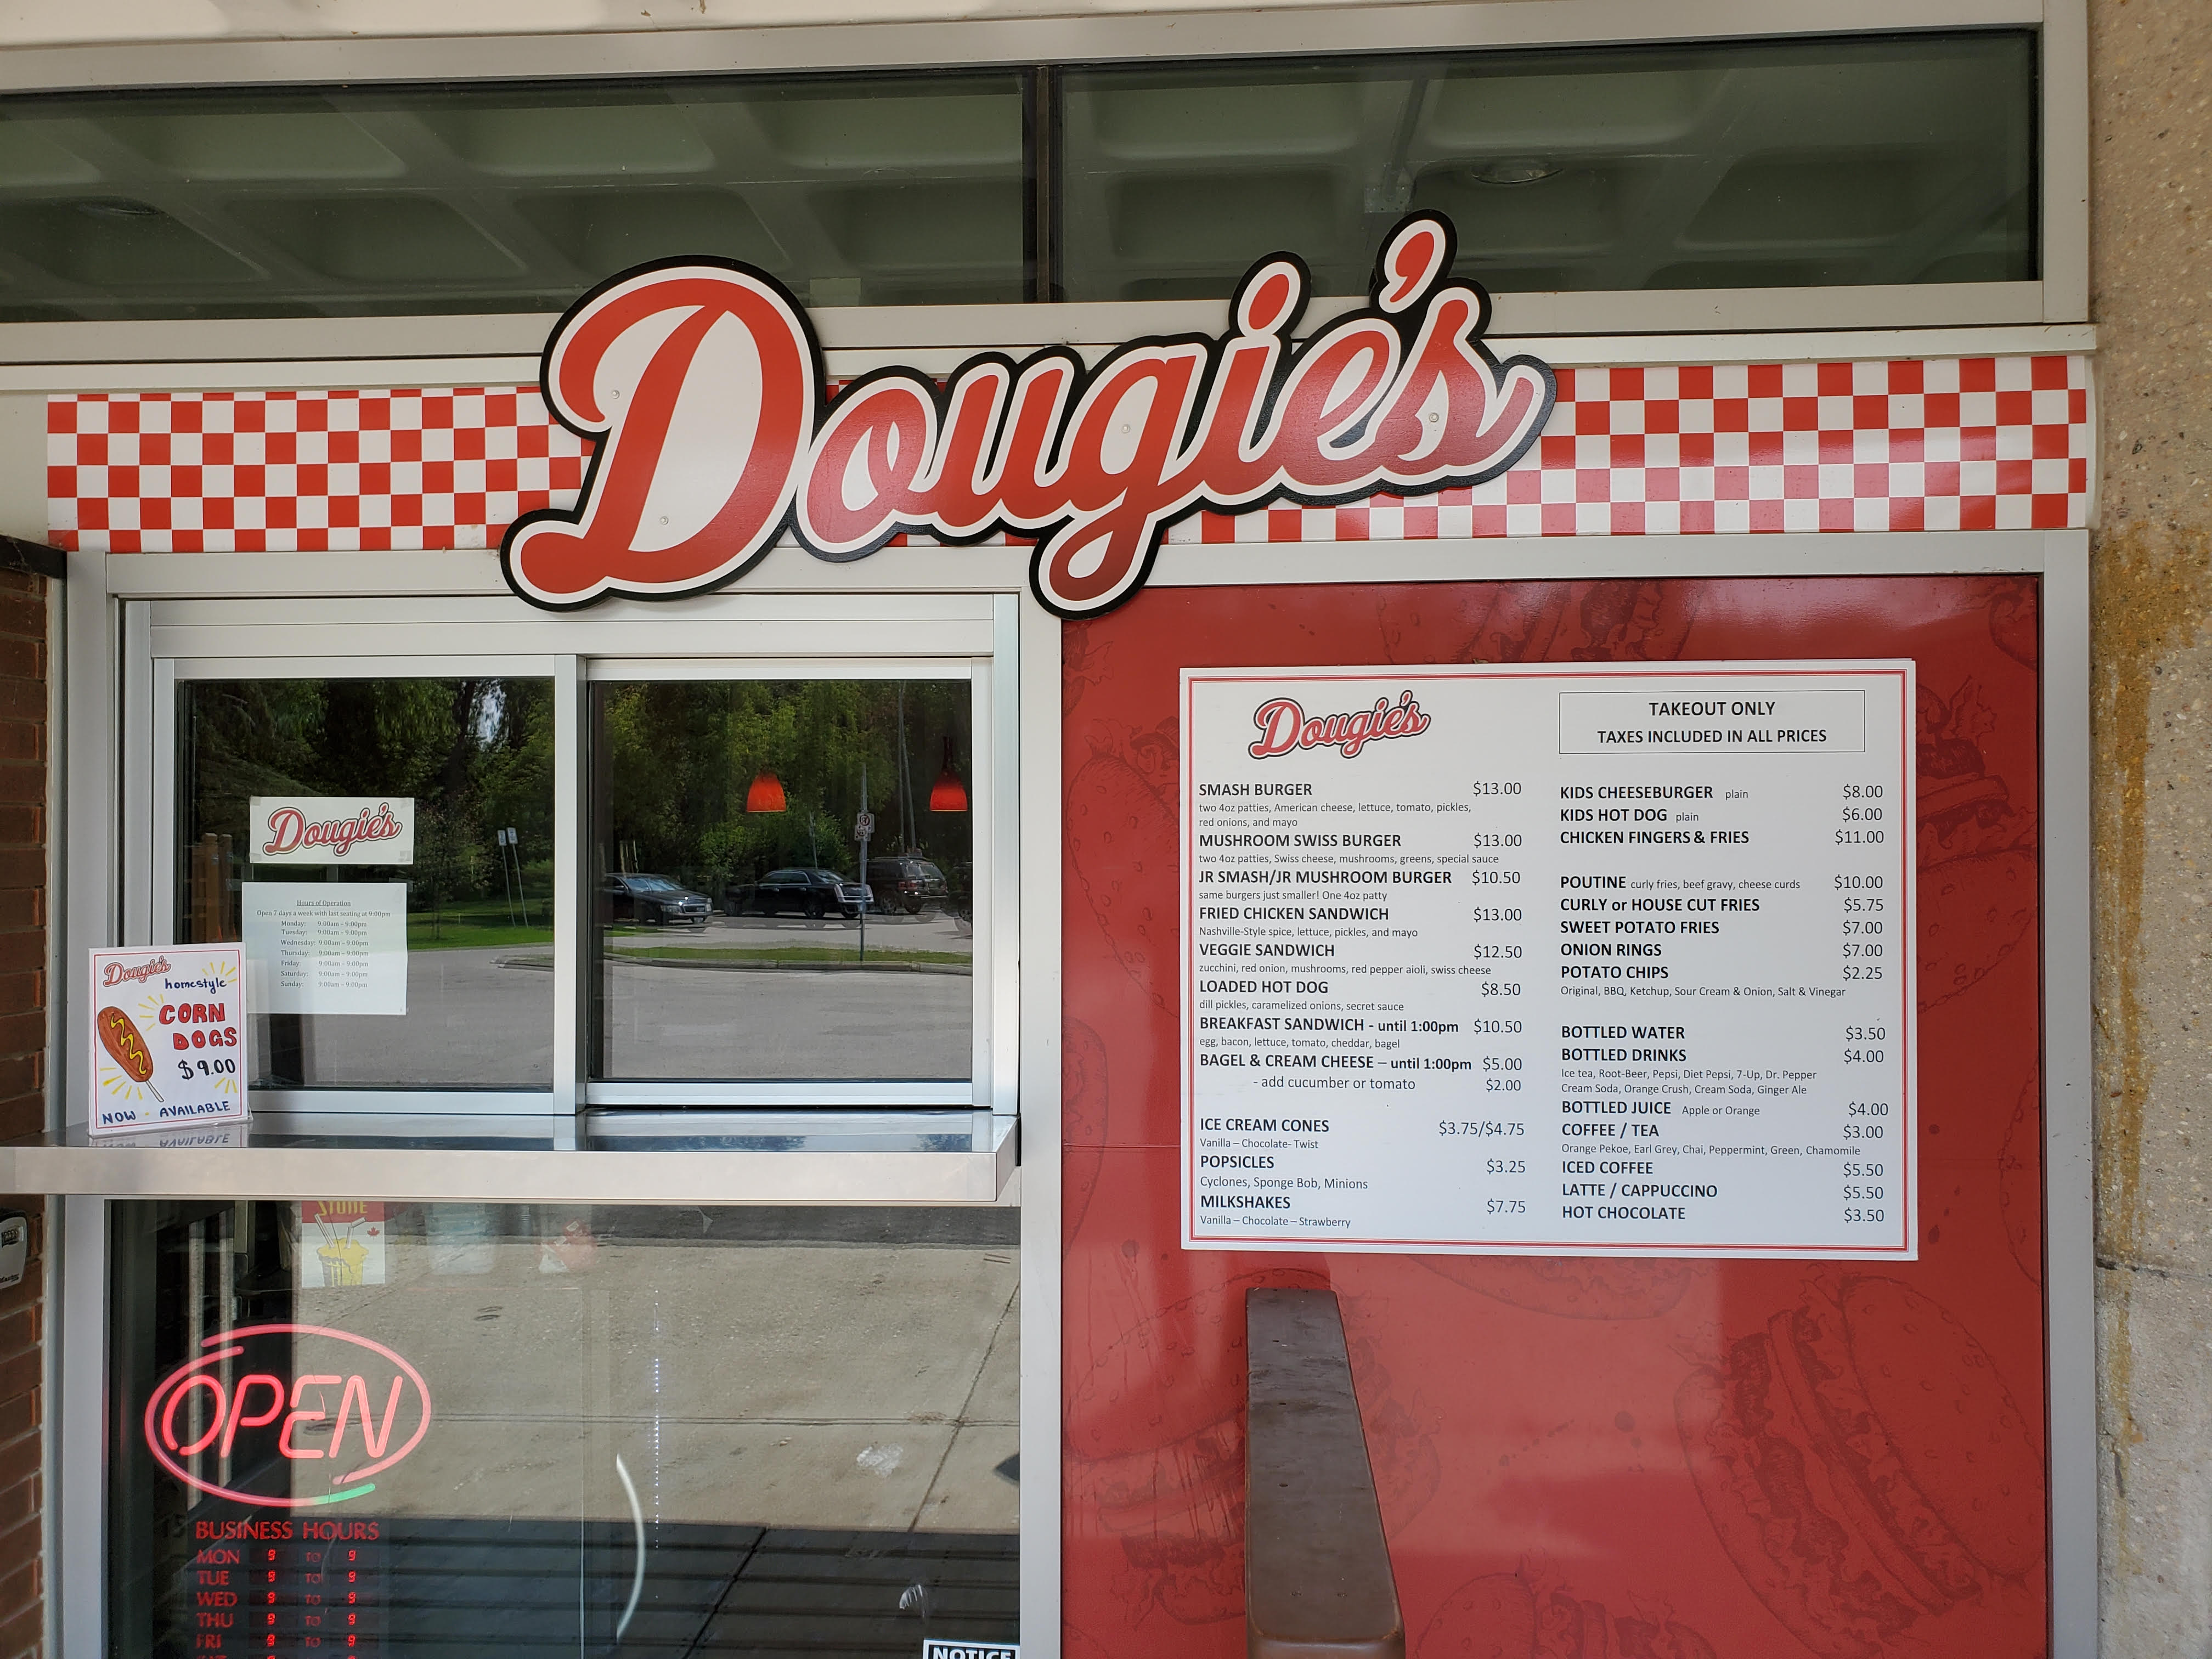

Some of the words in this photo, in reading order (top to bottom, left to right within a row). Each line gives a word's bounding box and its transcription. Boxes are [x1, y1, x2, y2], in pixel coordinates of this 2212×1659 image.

[501, 208, 1556, 619] Dougie's
[1648, 702, 1727, 716] TAKEOUT
[1731, 701, 1776, 716] ONLY
[1248, 690, 1431, 759] Dougie's
[1597, 730, 1644, 743] TAXES
[1648, 730, 1723, 743] INCLUDED
[1727, 730, 1742, 743] IN
[1746, 730, 1773, 743] ALL
[1777, 729, 1827, 742] PRICES
[1199, 783, 1250, 796] SMASH
[1254, 783, 1313, 796] BURGER
[1472, 780, 1521, 797] $13.00
[1560, 786, 1594, 799] KIDS
[1598, 786, 1713, 799] CHEESEBURGER
[1725, 789, 1748, 801] plain
[1843, 783, 1883, 800] $8.00
[1198, 804, 1217, 812] two
[1218, 803, 1236, 812] 4oz
[1238, 803, 1272, 815] patties,
[1273, 803, 1318, 812] American
[1321, 802, 1356, 814] cheese,
[1358, 802, 1393, 813] lettuce,
[1396, 803, 1434, 813] tomato,
[1437, 802, 1471, 814] pickles,
[1560, 809, 1594, 822] KIDS
[1598, 809, 1630, 821] HOT
[1634, 808, 1667, 821] DOG
[1842, 805, 1882, 823] $6.00
[1199, 817, 1214, 827] red
[1216, 817, 1250, 828] onions,
[1252, 817, 1270, 827] and
[1272, 819, 1298, 829] mayo
[1675, 811, 1699, 823] plain
[263, 802, 403, 856] Dougie's
[1560, 831, 1624, 844] CHICKEN
[1629, 831, 1691, 844] FINGERS
[1693, 830, 1706, 844] &
[1710, 831, 1750, 844] FRIES
[1835, 828, 1884, 846] $11.00
[1199, 834, 1290, 847] MUSHROOM
[1293, 834, 1338, 847] SWISS
[1342, 834, 1402, 847] BURGER
[1473, 832, 1522, 849] $13.00
[1198, 870, 1214, 883] JR
[1217, 869, 1292, 886] SMASH/JR
[1296, 871, 1387, 884] MUSHROOM
[1392, 871, 1452, 884] BURGER
[1472, 869, 1520, 886] $10.50
[1561, 876, 1627, 889] POUTINE
[1630, 879, 1654, 891] curly
[1656, 879, 1680, 890] fries,
[1683, 879, 1706, 889] beef
[1707, 882, 1736, 891] gravy,
[1738, 879, 1772, 889] cheese
[1774, 879, 1801, 889] curds
[1834, 874, 1883, 891] $10.00
[1560, 898, 1608, 911] CURLY
[1611, 901, 1628, 911] or
[1632, 898, 1683, 911] HOUSE
[1686, 898, 1717, 911] CUT
[1720, 898, 1760, 911] FRIES
[1843, 896, 1883, 913] $5.75
[1199, 907, 1239, 919] FRIED
[1243, 907, 1304, 920] CHICKEN
[1308, 907, 1389, 921] SANDWICH
[1473, 906, 1522, 923] $13.00
[1560, 921, 1611, 934] SWEET
[1615, 921, 1676, 934] POTATO
[1680, 921, 1719, 934] FRIES
[1842, 919, 1883, 936] $7.00
[1199, 943, 1251, 956] VEGGIE
[1255, 943, 1334, 957] SANDWICH
[1474, 943, 1522, 961] $12.50
[1561, 943, 1611, 956] ONION
[1617, 943, 1662, 956] RINGS
[1842, 941, 1883, 960] $7.00
[103, 955, 171, 987] Dougie's
[1561, 966, 1622, 979] POTATO
[1626, 966, 1669, 979] CHIPS
[1843, 964, 1882, 982] $2.25
[165, 978, 227, 994] homestyle
[1200, 980, 1257, 993] LOADED
[1262, 980, 1293, 994] HOT
[1296, 980, 1328, 994] DOG
[1481, 980, 1521, 998] $8.50
[159, 1003, 225, 1025] CORN
[173, 1027, 237, 1050] DOGS
[1562, 1025, 1627, 1039] BOTTLED
[1631, 1026, 1685, 1039] WATER
[1845, 1025, 1886, 1042] $3.50
[1562, 1048, 1627, 1062] BOTTLED
[1632, 1048, 1687, 1062] DRINKS
[1844, 1047, 1884, 1065] $4.00
[177, 1058, 236, 1080] $9.00
[102, 1110, 136, 1124] NOW
[160, 1101, 230, 1118] AVAILABLE
[1562, 1101, 1628, 1114] BOTTLED
[1630, 1101, 1672, 1114] JUICE
[1681, 1105, 1710, 1117] Apple
[1725, 1105, 1760, 1117] Orange
[1848, 1101, 1889, 1118] $4.00
[1200, 1118, 1222, 1131] ICE
[1226, 1118, 1277, 1132] CREAM
[1281, 1119, 1329, 1132] CONES
[1438, 1120, 1524, 1137] $3.75/$4.75
[1200, 1155, 1274, 1169] POPSICLES
[1486, 1158, 1526, 1175] $3.25
[1562, 1160, 1595, 1174] ICED
[1599, 1161, 1654, 1175] COFFEE
[1843, 1161, 1883, 1178] $5.50
[1201, 1195, 1291, 1209] MILKSHAKES
[1487, 1198, 1526, 1215] $7.75
[1562, 1205, 1594, 1218] HOT
[1598, 1206, 1686, 1220] CHOCOLATE
[1844, 1206, 1884, 1224] $3.50
[162, 1376, 402, 1457] OPEN
[195, 1521, 293, 1540] BUSINESS
[302, 1521, 380, 1540] HOURS
[196, 1549, 240, 1564] MON
[197, 1570, 229, 1585] TUE
[196, 1634, 222, 1648] FRI
